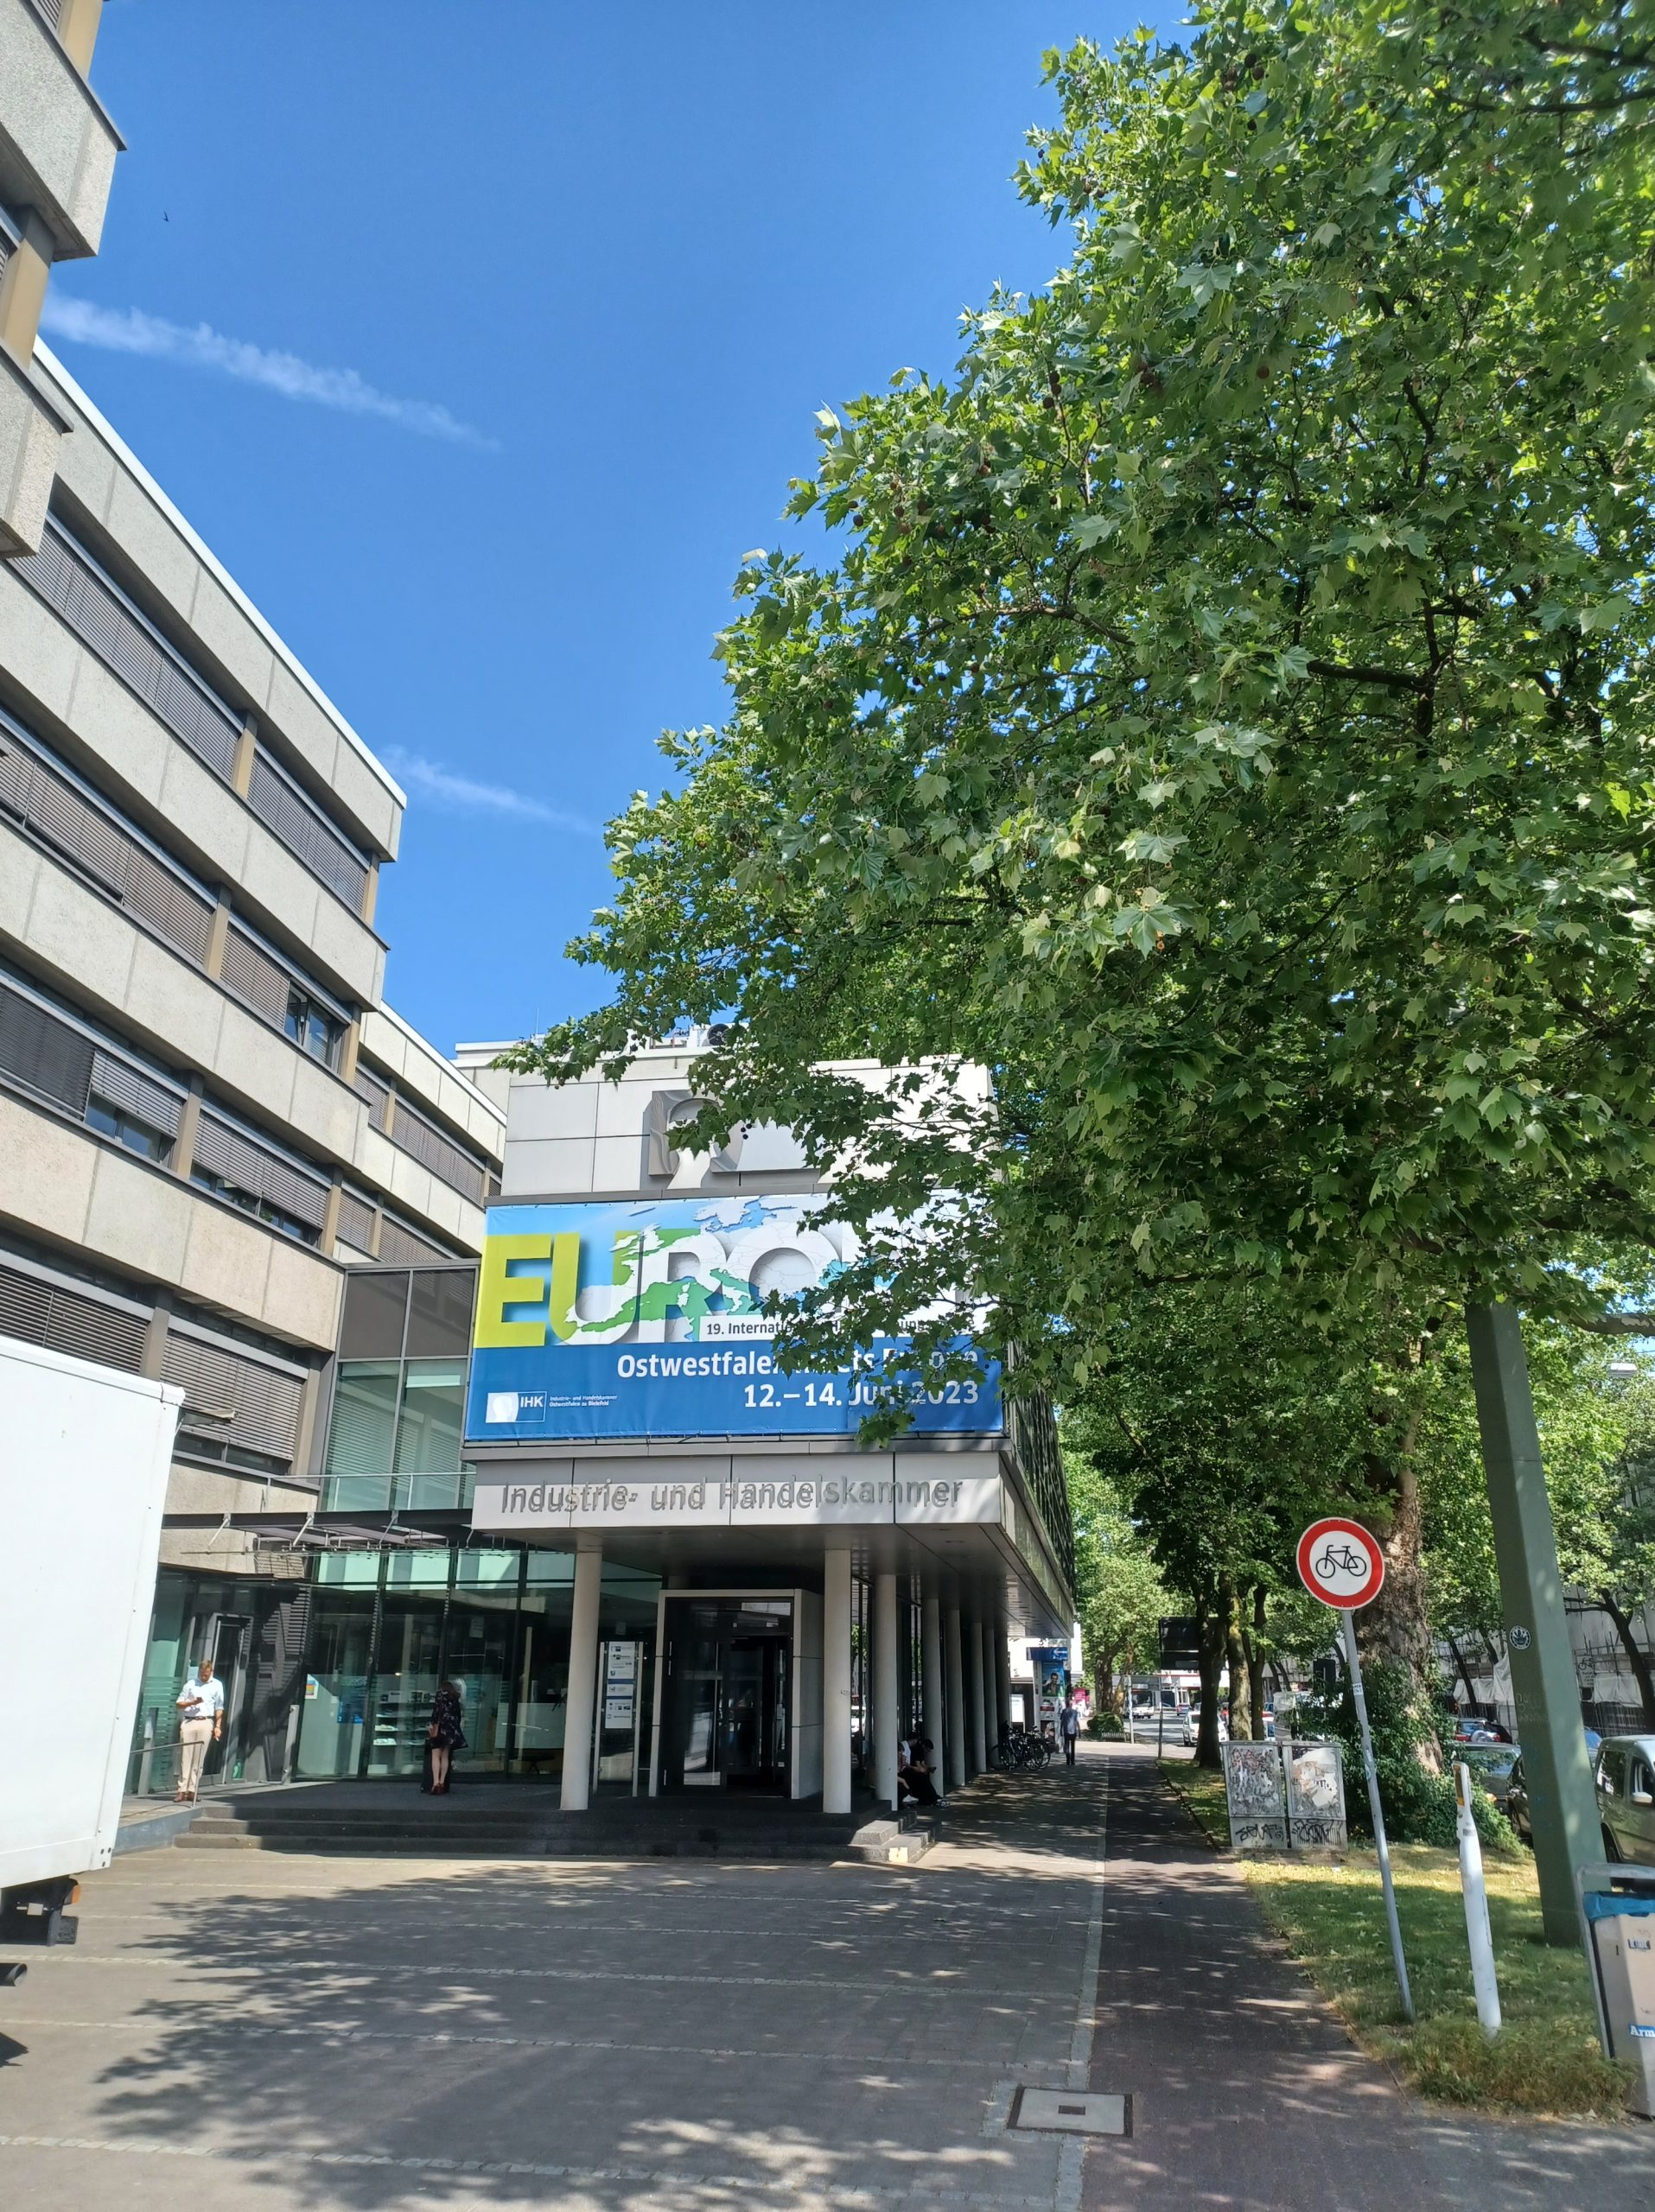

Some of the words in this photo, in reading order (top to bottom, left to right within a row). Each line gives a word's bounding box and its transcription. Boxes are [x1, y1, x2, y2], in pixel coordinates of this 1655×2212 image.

[706, 1323, 725, 1336] 19.
[617, 1350, 785, 1378] Ostwestfale
[519, 1395, 544, 1408] IHK
[501, 1478, 638, 1514] Industrie-
[651, 1476, 708, 1511] und
[719, 1473, 964, 1510] Handelskammer
